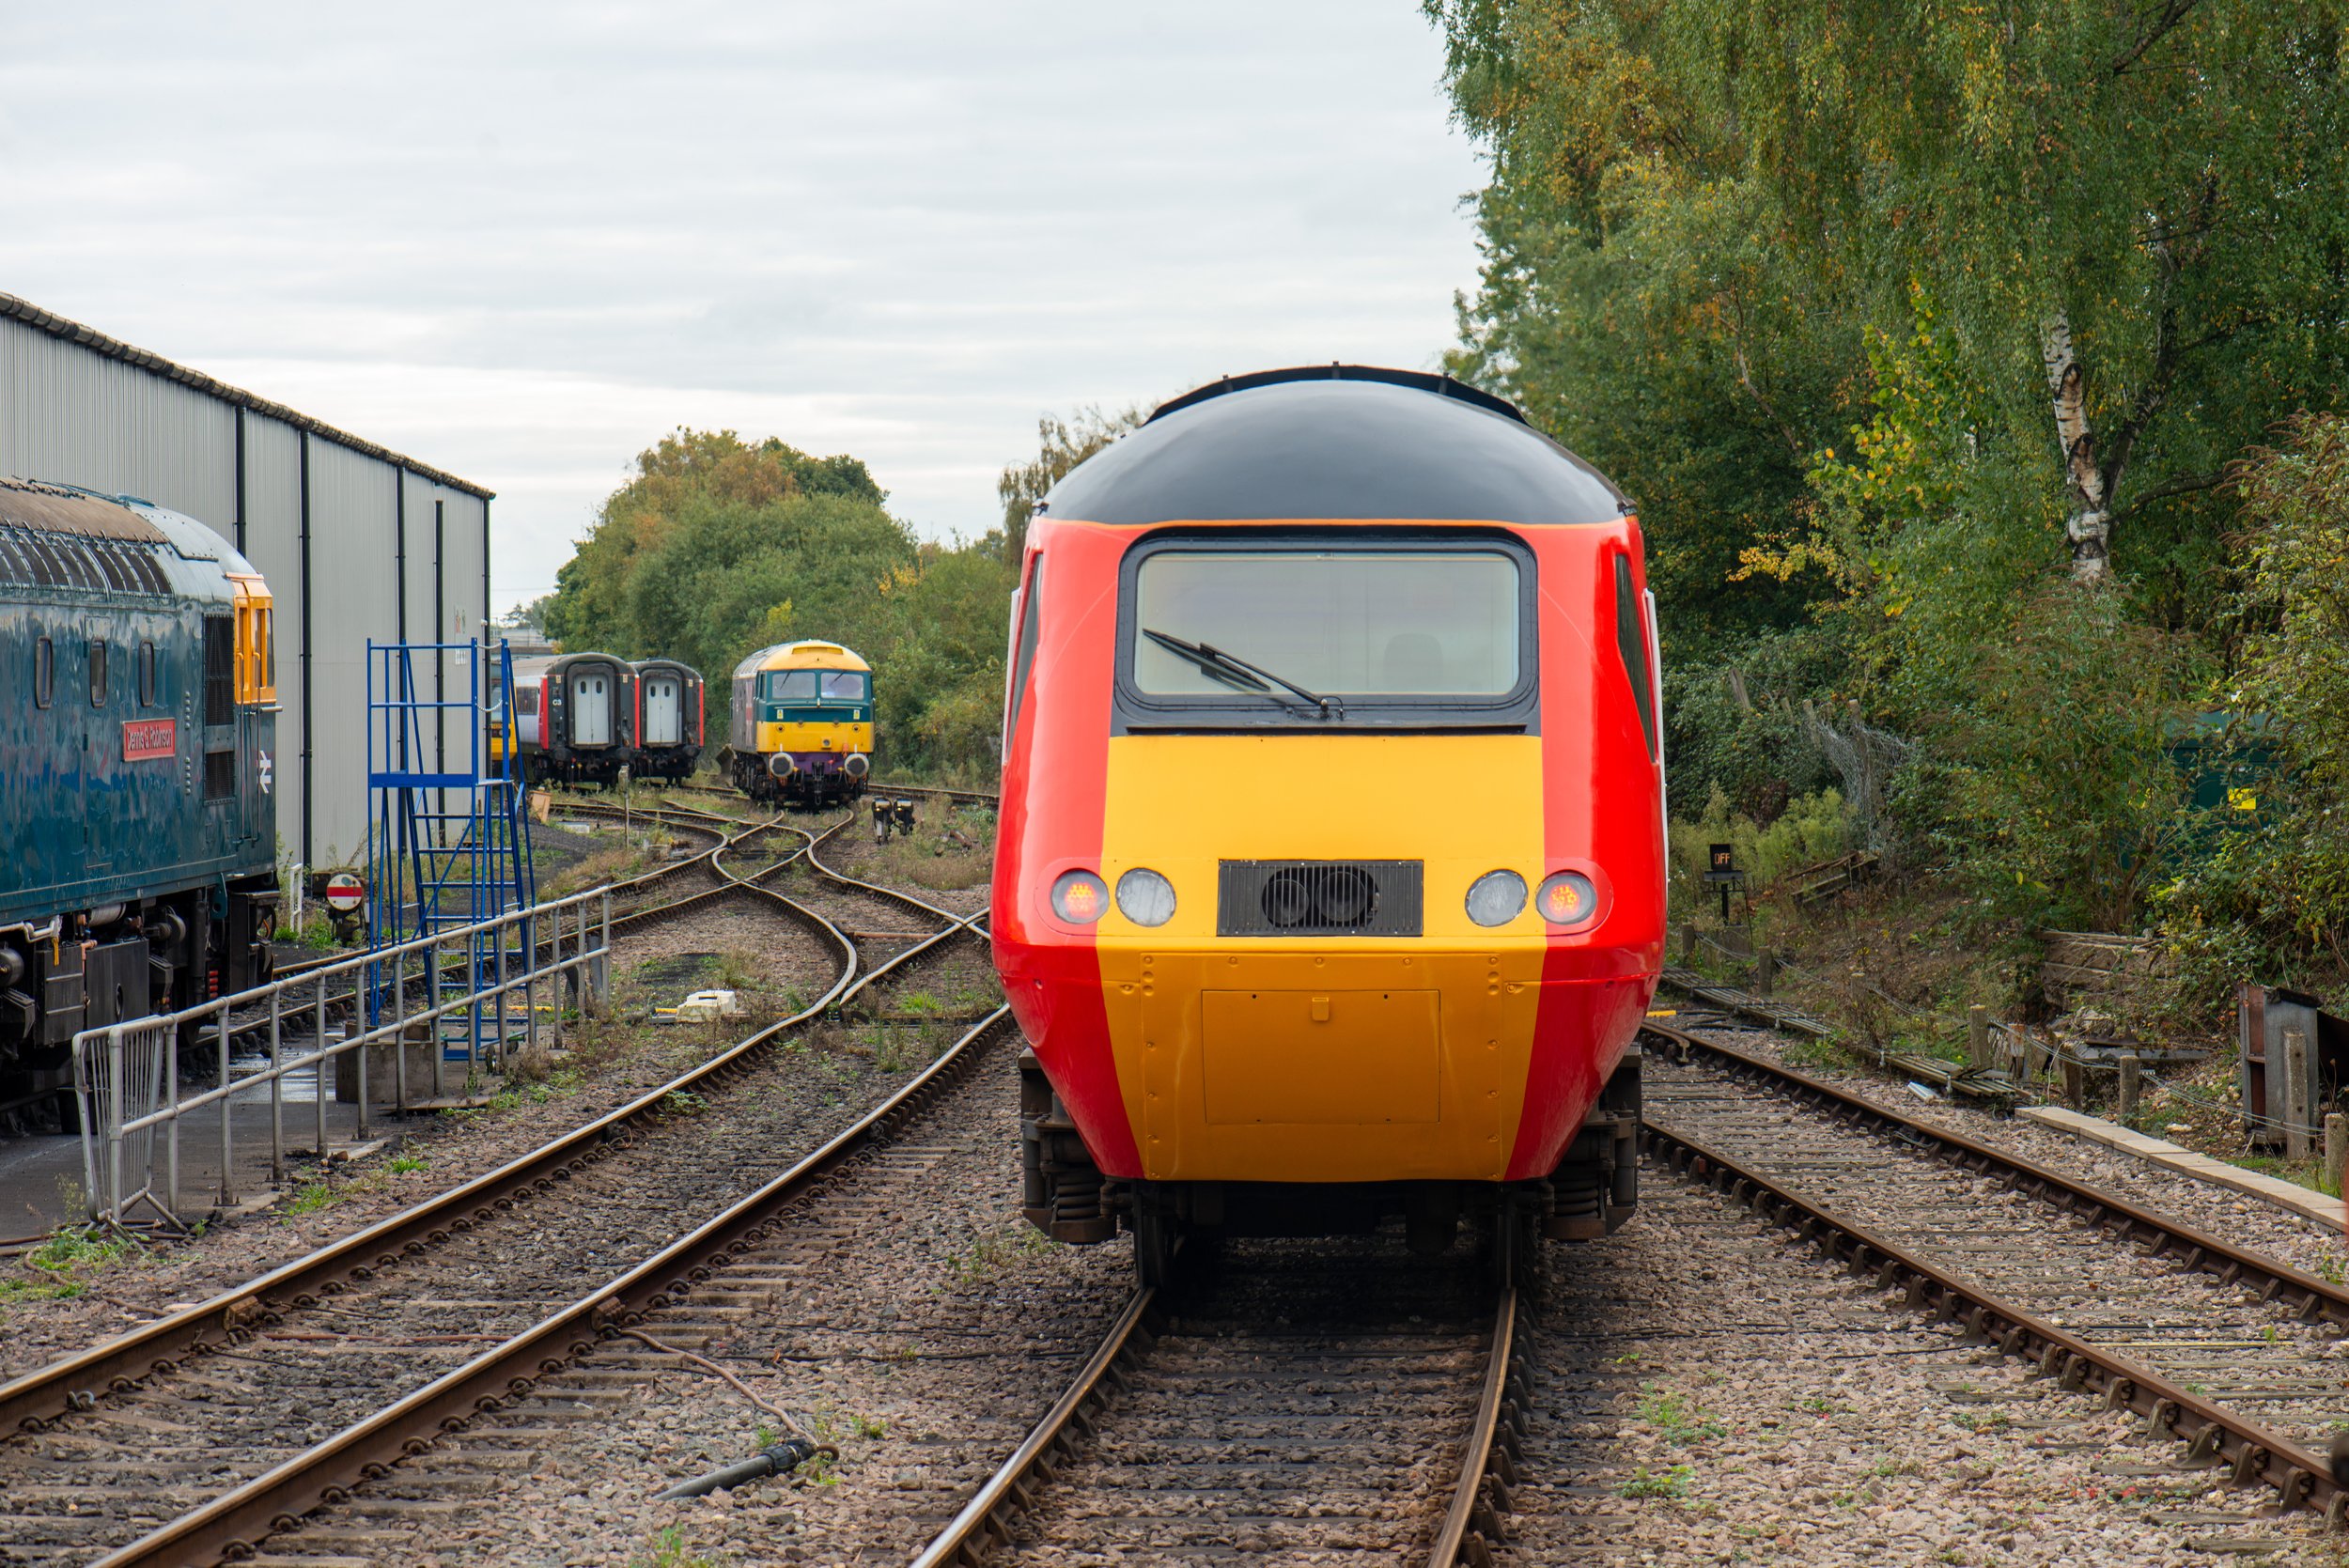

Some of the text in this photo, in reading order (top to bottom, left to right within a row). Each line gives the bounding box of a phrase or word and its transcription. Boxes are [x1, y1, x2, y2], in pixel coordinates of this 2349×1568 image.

[128, 727, 144, 752] Dennis
[150, 724, 172, 748] Robinson
[1714, 852, 1730, 864] OFF
